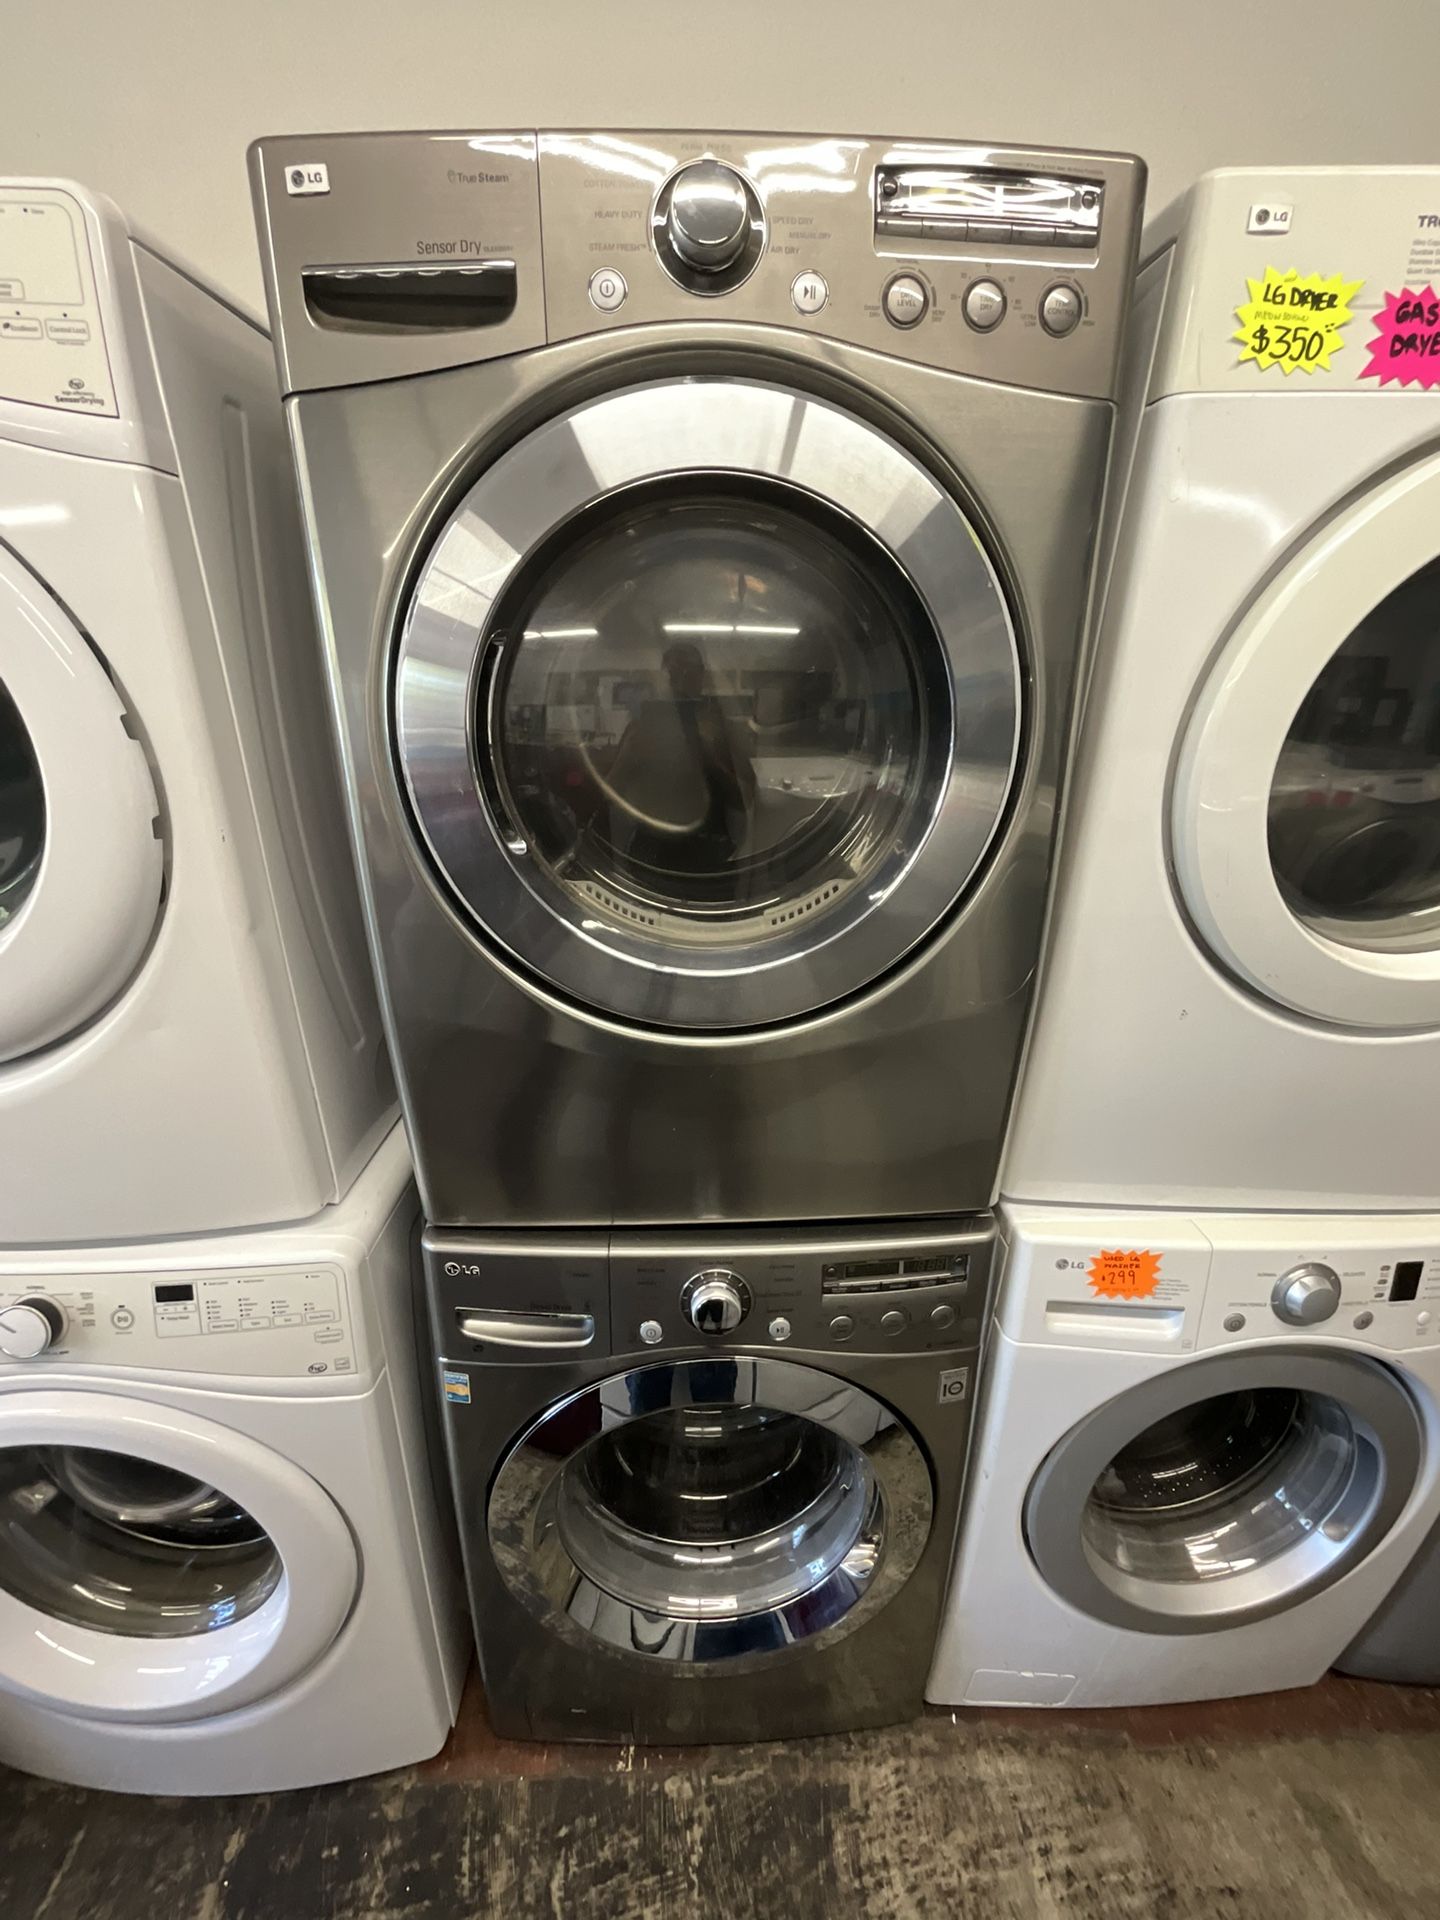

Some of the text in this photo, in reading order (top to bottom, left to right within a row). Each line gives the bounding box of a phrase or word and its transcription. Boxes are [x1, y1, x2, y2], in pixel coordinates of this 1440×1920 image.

[307, 172, 323, 183] LG
[1273, 211, 1288, 222] LG
[416, 241, 457, 255] Sensor
[460, 239, 482, 255] Dry
[785, 247, 801, 255] DRY
[1263, 283, 1338, 311] LG DRYER
[1395, 300, 1440, 327] GAS
[462, 1264, 481, 1276] LG
